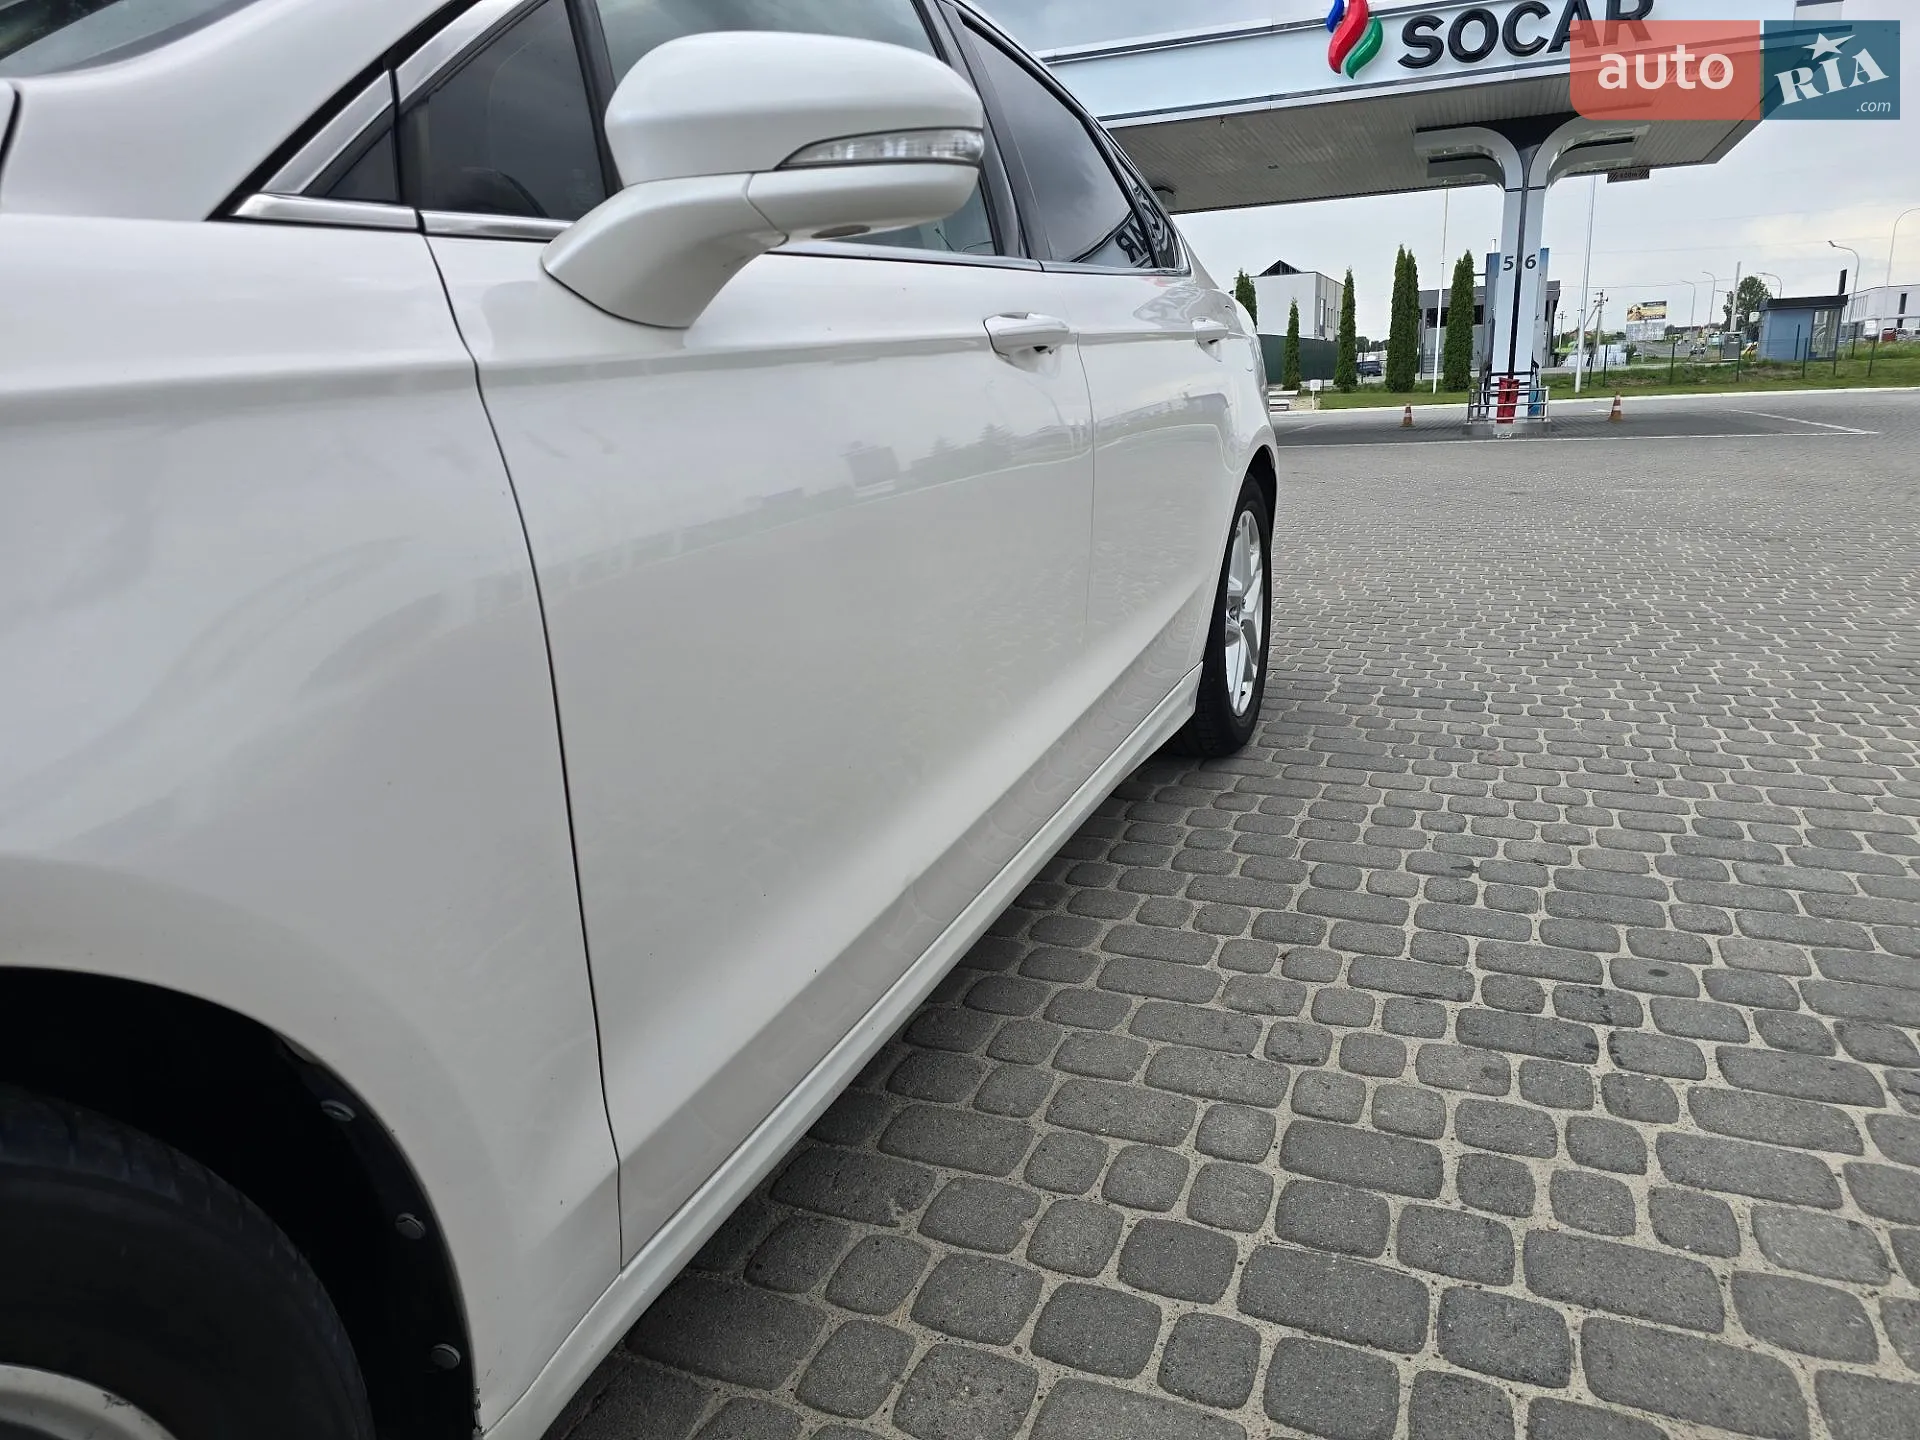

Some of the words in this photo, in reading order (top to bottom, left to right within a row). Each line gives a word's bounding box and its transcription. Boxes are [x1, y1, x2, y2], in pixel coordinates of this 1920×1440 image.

[1397, 0, 1654, 69] SOCAR
[1503, 255, 1514, 271] 5
[1525, 254, 1537, 270] 6
